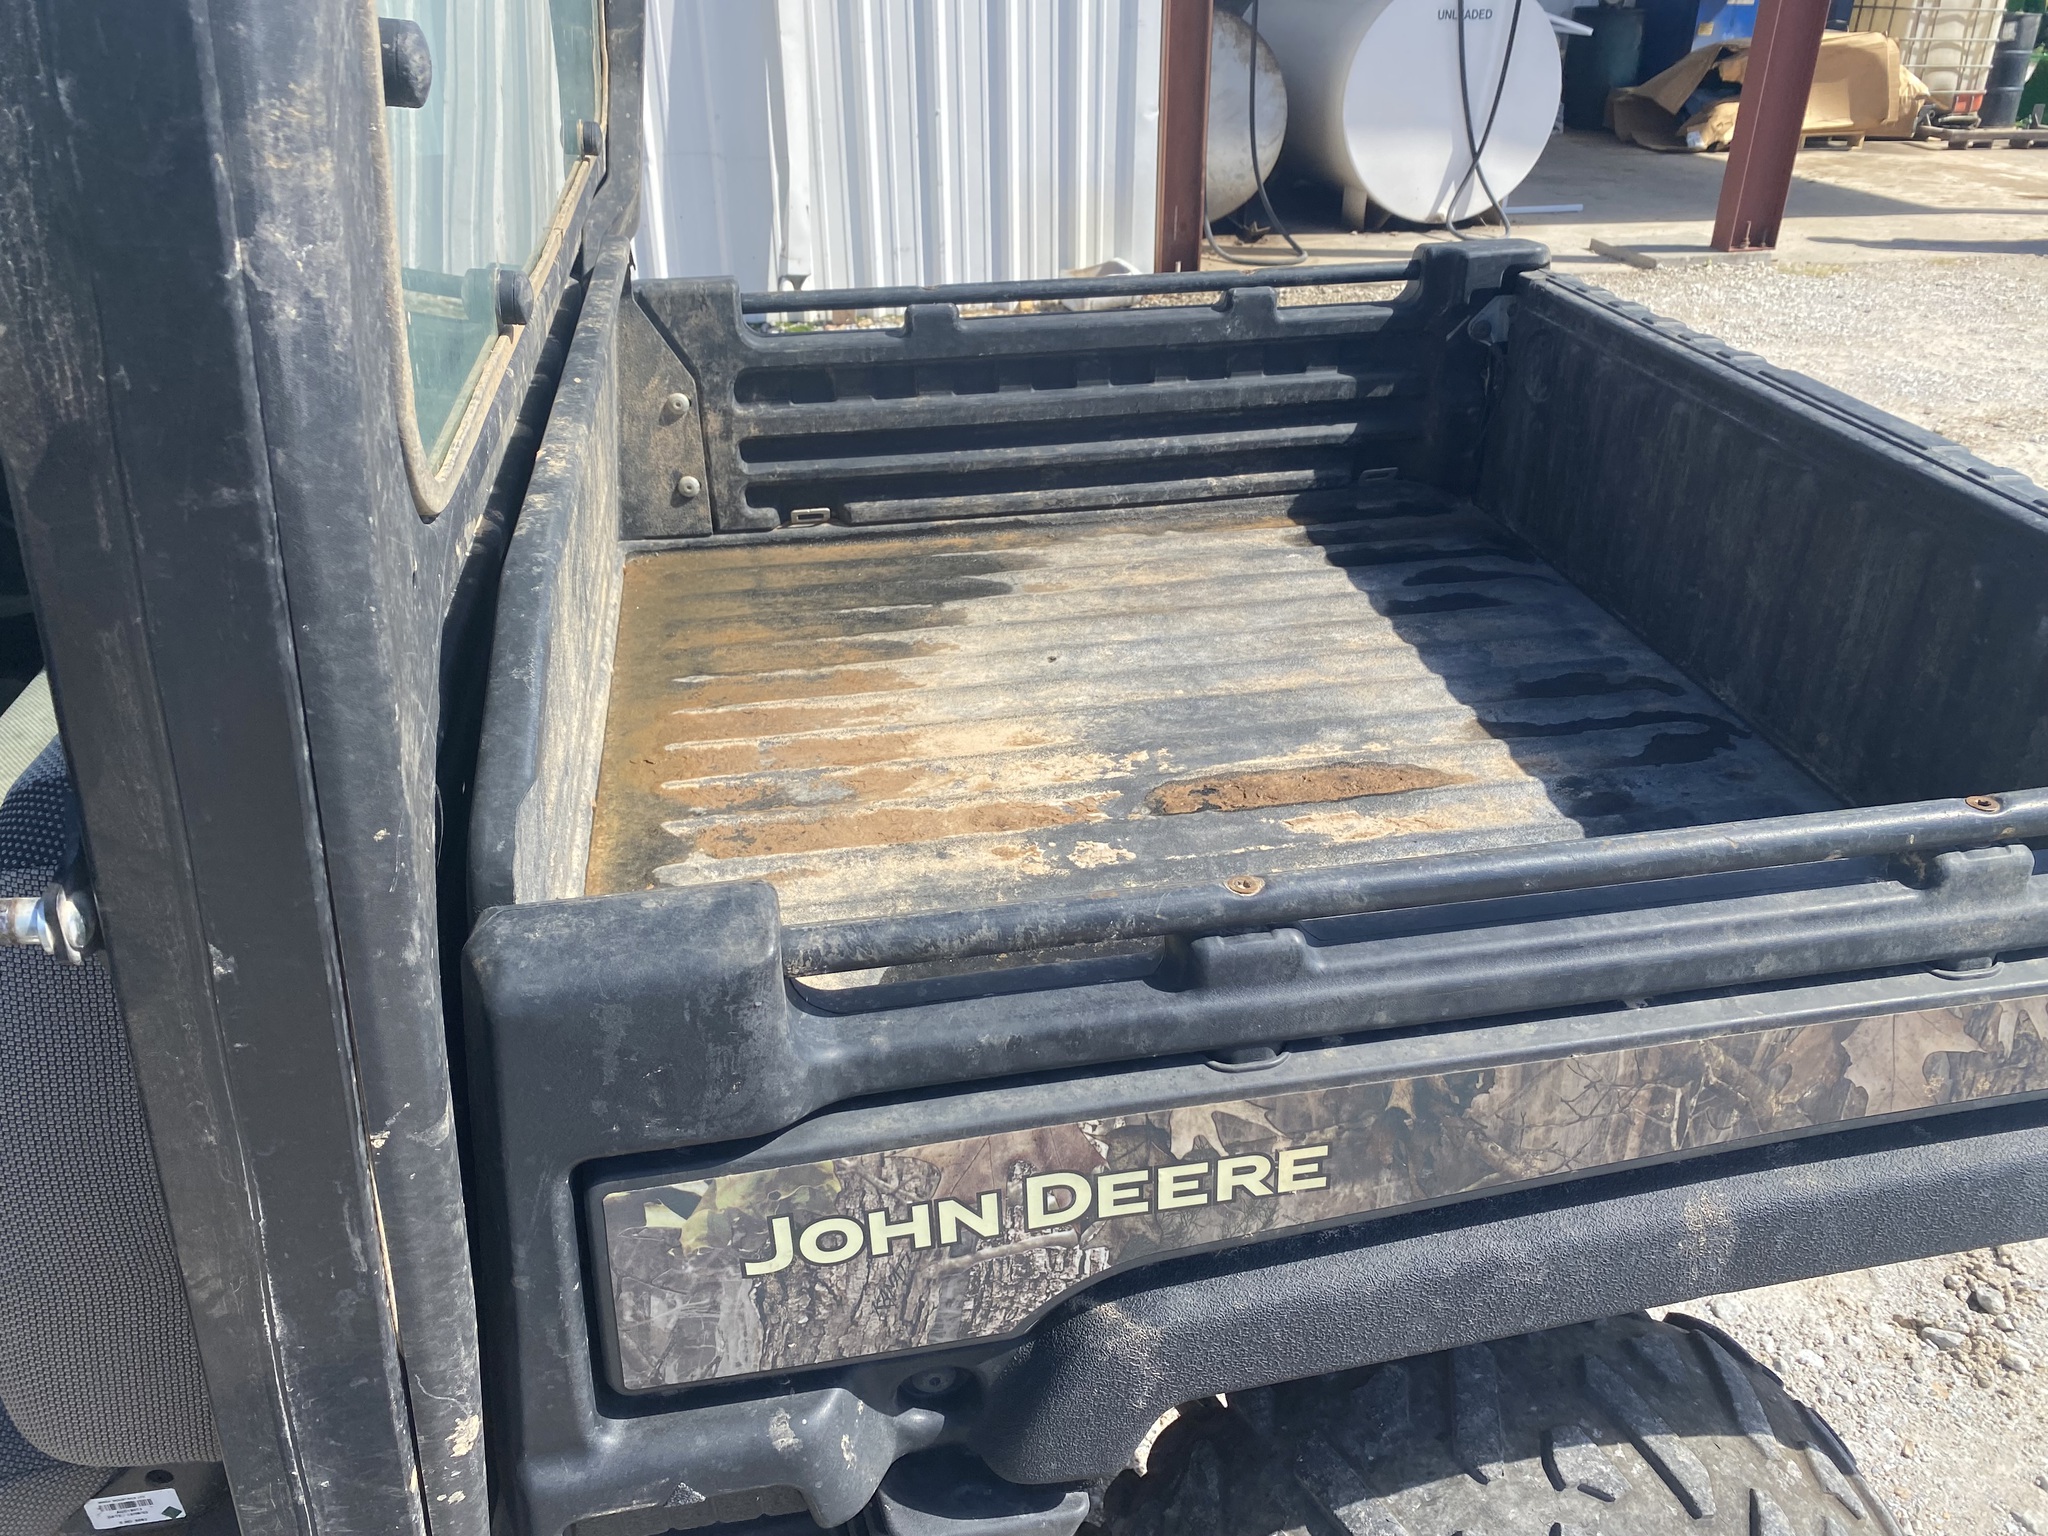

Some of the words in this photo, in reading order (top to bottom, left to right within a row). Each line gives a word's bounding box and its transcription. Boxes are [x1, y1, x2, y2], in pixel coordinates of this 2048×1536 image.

[1437, 8, 1493, 20] UNLADED
[743, 1191, 1000, 1277] JOHN
[1026, 1145, 1330, 1230] DEERE
